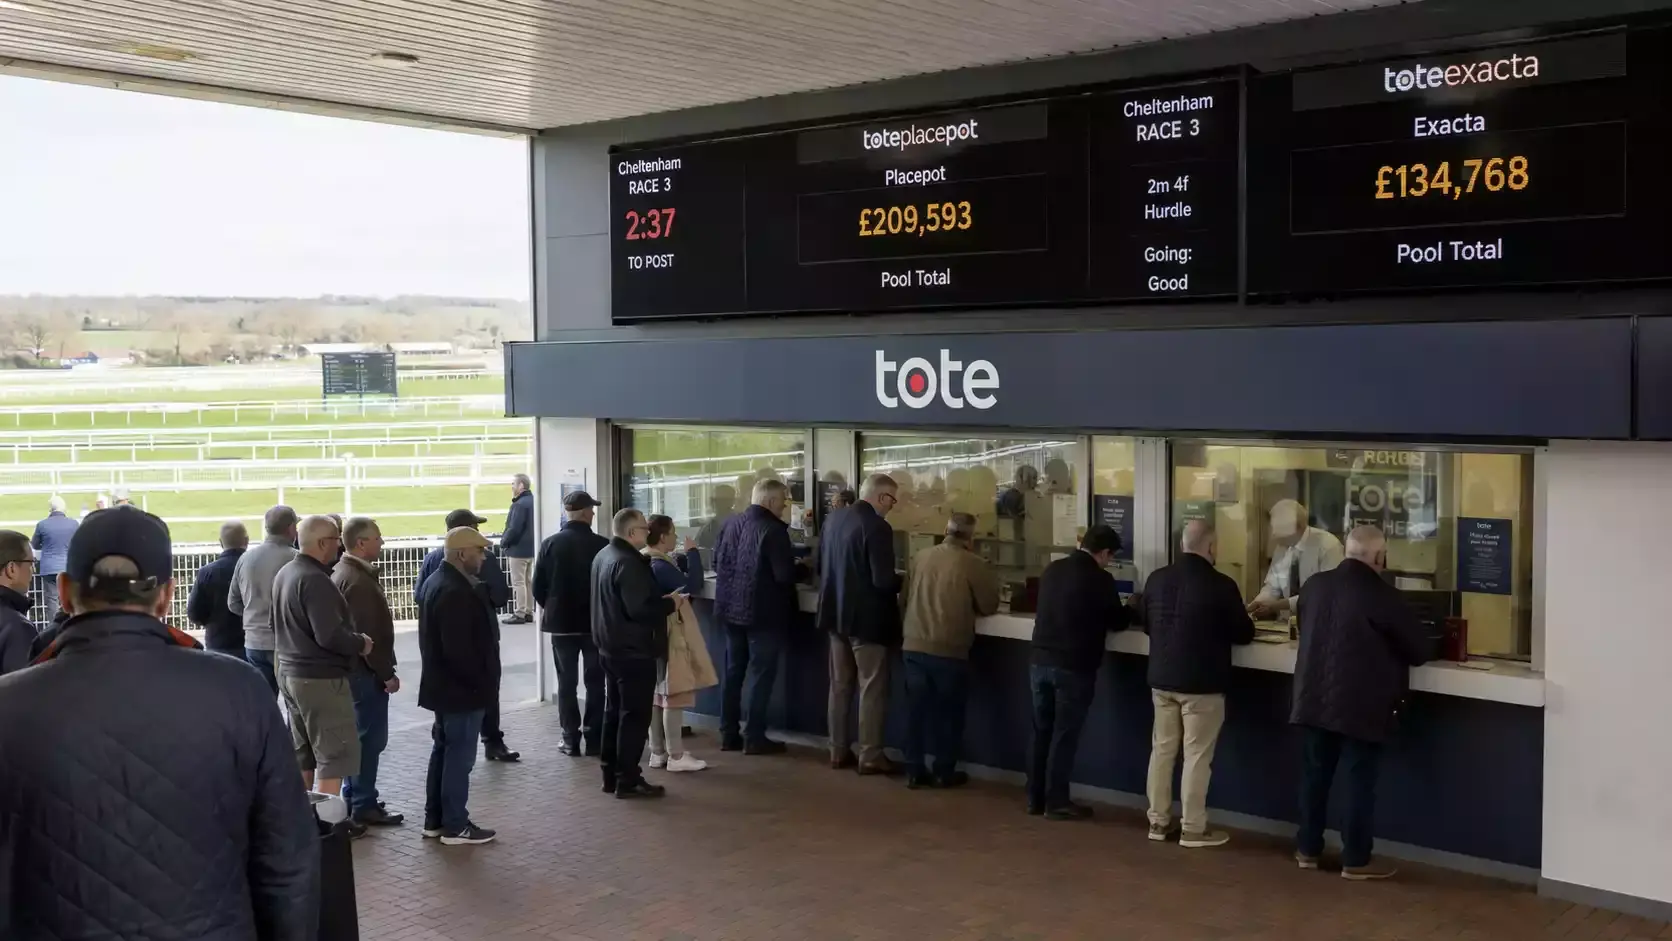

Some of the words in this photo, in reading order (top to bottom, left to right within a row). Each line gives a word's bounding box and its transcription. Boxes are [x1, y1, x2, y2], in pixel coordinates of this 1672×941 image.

[1384, 53, 1539, 93] toteexacta
[1123, 94, 1214, 119] Cheltenham
[864, 119, 979, 151] toteplacepot
[1136, 121, 1182, 142] RACE
[1189, 119, 1200, 137] 3
[1414, 113, 1486, 137] Exacta
[618, 157, 682, 176] Cheltenham
[885, 165, 946, 186] Placepot
[1375, 155, 1529, 200] £134,768
[629, 178, 660, 195] RACE
[663, 177, 672, 192] 3
[1147, 179, 1170, 194] 2m
[1173, 175, 1190, 192] 4f
[859, 200, 972, 236] £209,593
[1144, 201, 1192, 220] Hurdle
[625, 207, 676, 240] 2:37
[627, 255, 643, 270] TO
[645, 254, 675, 269] POST
[1144, 246, 1193, 265] Going:
[1397, 242, 1443, 264] Pool
[1449, 238, 1503, 261] Total
[881, 270, 912, 288] Pool
[915, 267, 951, 286] Total
[1148, 274, 1188, 292] Good
[875, 348, 1000, 409] tote
[1345, 479, 1423, 513] tote
